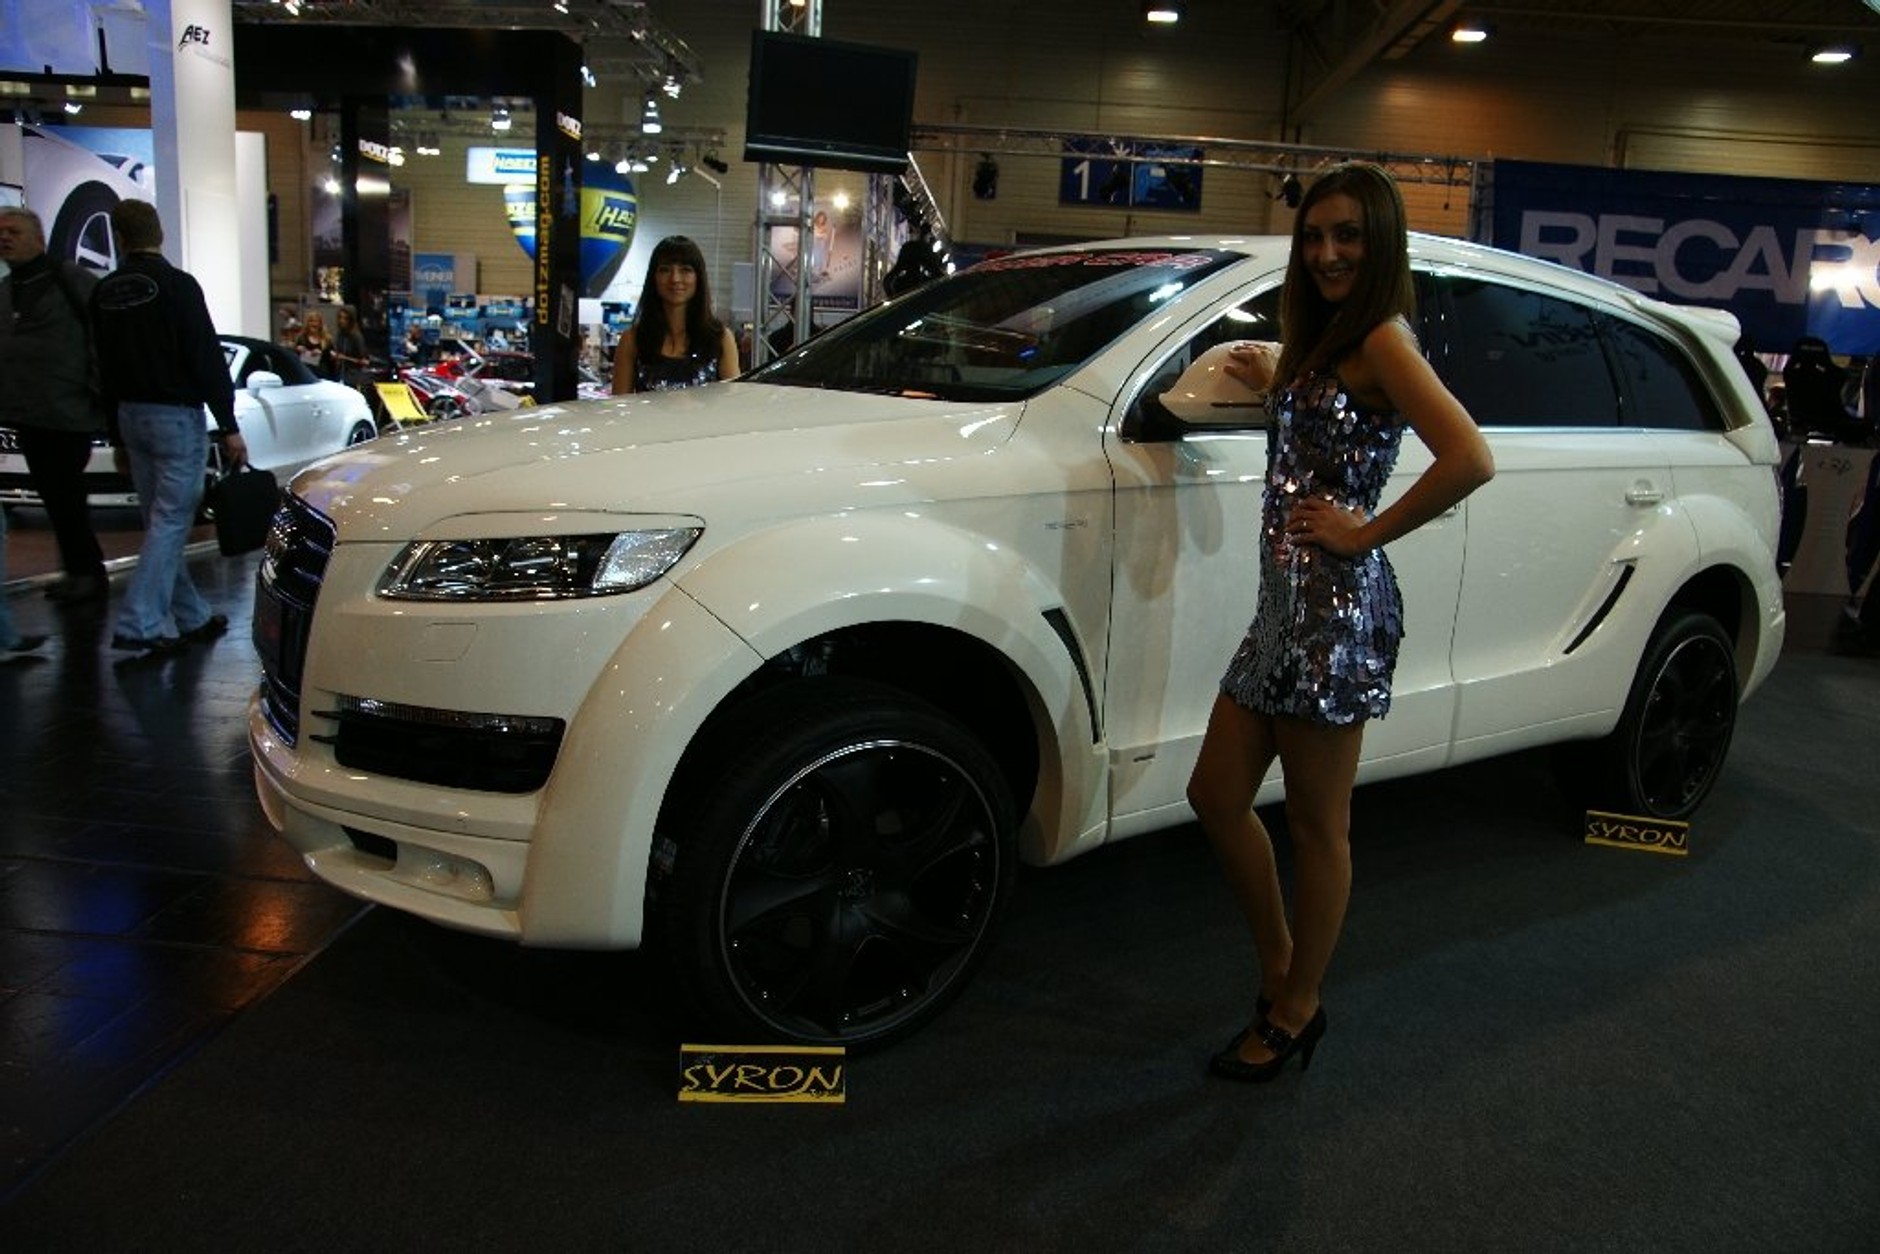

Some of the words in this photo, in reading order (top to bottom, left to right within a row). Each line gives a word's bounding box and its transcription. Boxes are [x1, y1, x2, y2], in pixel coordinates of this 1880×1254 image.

[178, 24, 210, 52] AEZ
[1073, 160, 1090, 200] 1
[537, 155, 552, 324] dotzmag.com
[1587, 822, 1686, 847] SYRON
[680, 1062, 843, 1097] SYRON
